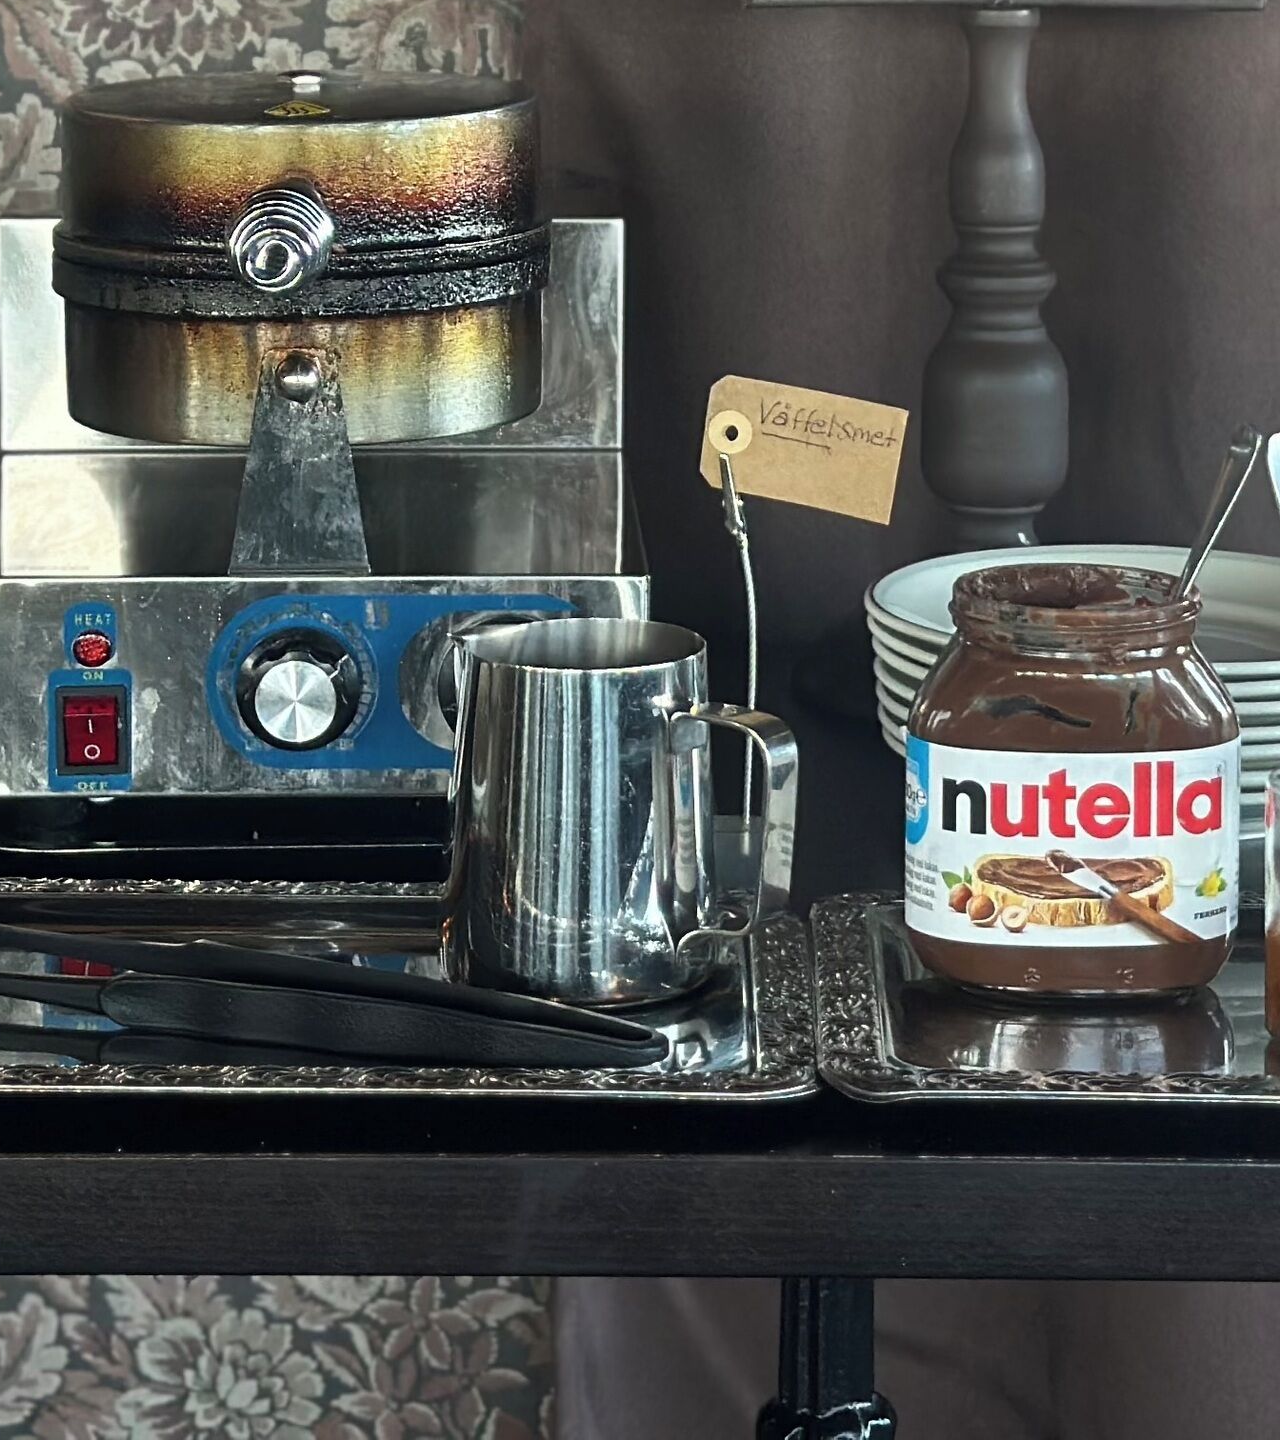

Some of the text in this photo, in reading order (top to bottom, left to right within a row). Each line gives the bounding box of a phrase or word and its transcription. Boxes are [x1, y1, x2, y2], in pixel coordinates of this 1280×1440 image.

[74, 613, 112, 626] HEAT
[82, 670, 104, 681] ON
[942, 761, 1223, 838] nutella
